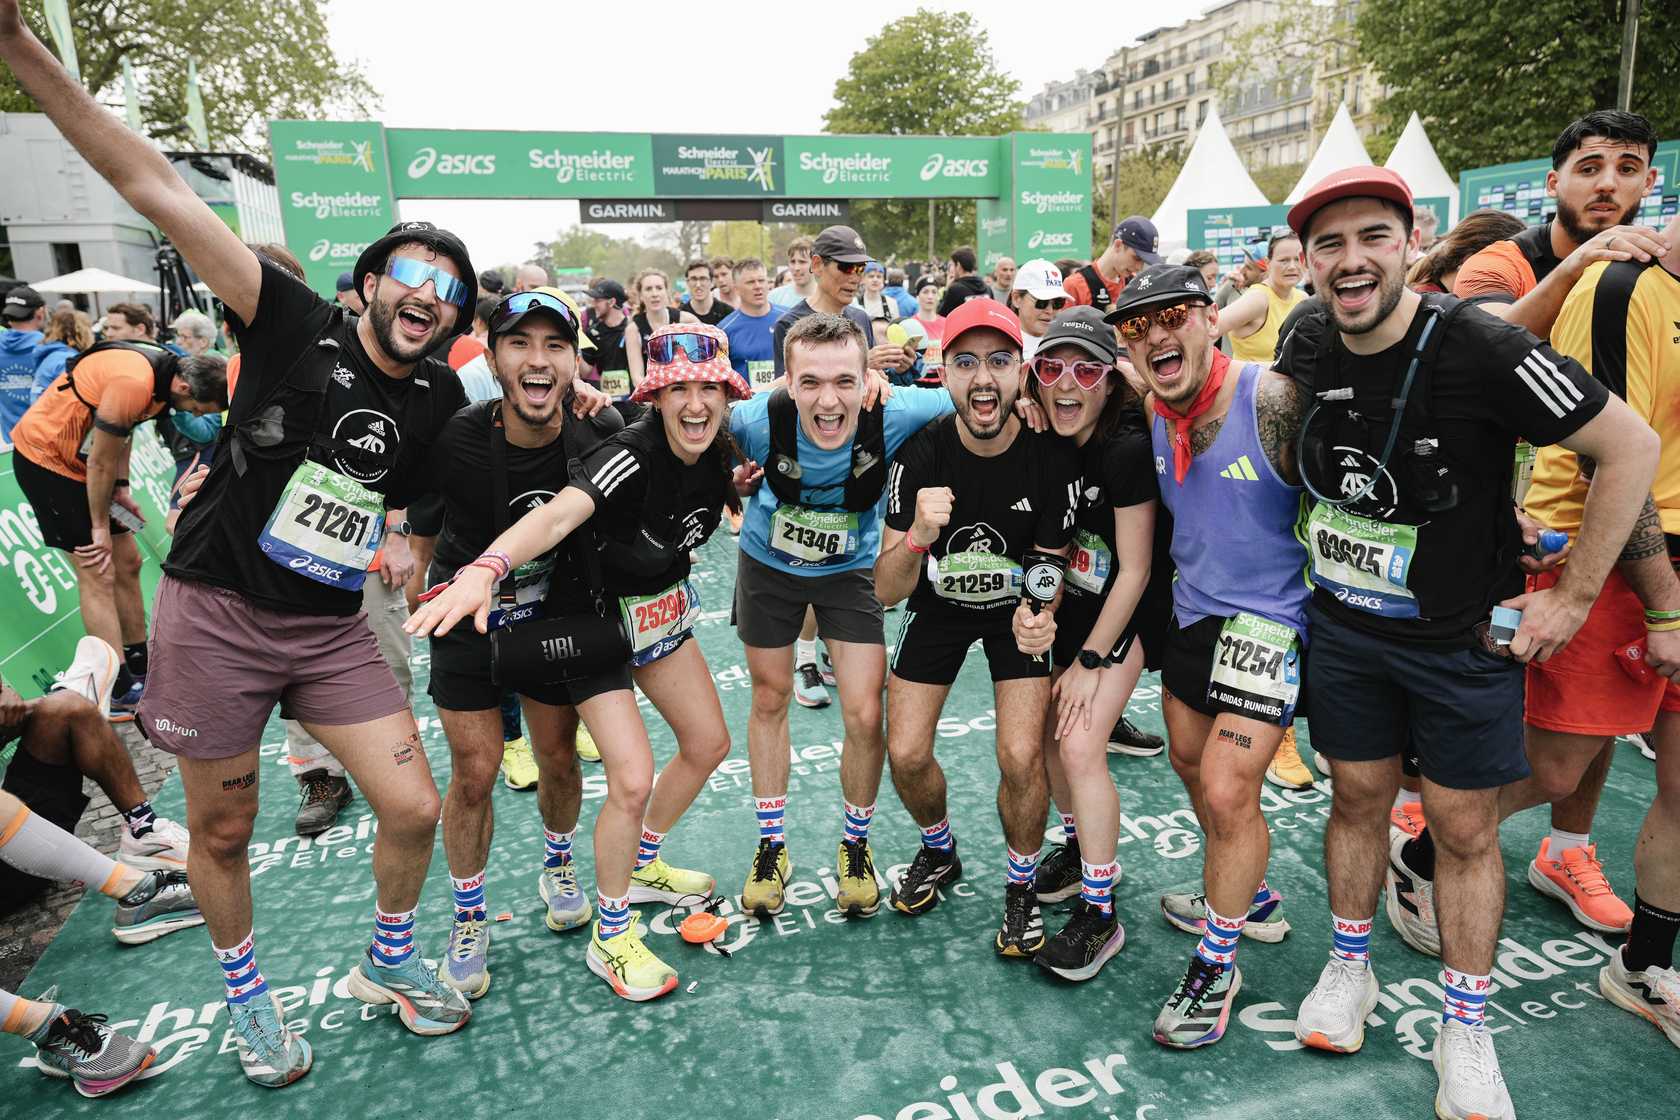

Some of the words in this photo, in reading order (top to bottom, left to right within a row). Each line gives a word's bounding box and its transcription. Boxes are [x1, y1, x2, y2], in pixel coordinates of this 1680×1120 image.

[529, 149, 635, 169] Schneider
[678, 146, 738, 159] Schneider
[437, 155, 496, 175] asics
[800, 152, 891, 171] Schneider
[943, 160, 989, 177] asics
[576, 169, 635, 182] Electric
[704, 167, 749, 179] PARIS
[840, 171, 890, 182] Electric
[291, 191, 381, 208] Schneider
[1021, 191, 1084, 204] Schneider
[331, 207, 382, 217] Electric
[330, 243, 372, 257] asic
[1062, 321, 1094, 333] respire
[294, 493, 370, 546] 21261
[782, 522, 840, 554] 21346
[307, 562, 343, 582] asics
[943, 572, 1005, 594] 21259
[1237, 612, 1296, 640] Schneide
[1219, 635, 1284, 681] 21254
[1219, 692, 1243, 708] ADIDAS
[1243, 699, 1282, 717] RUNNERS
[171, 721, 198, 737] i-run
[1218, 729, 1235, 740] DEAR
[1235, 732, 1252, 745] LEGS
